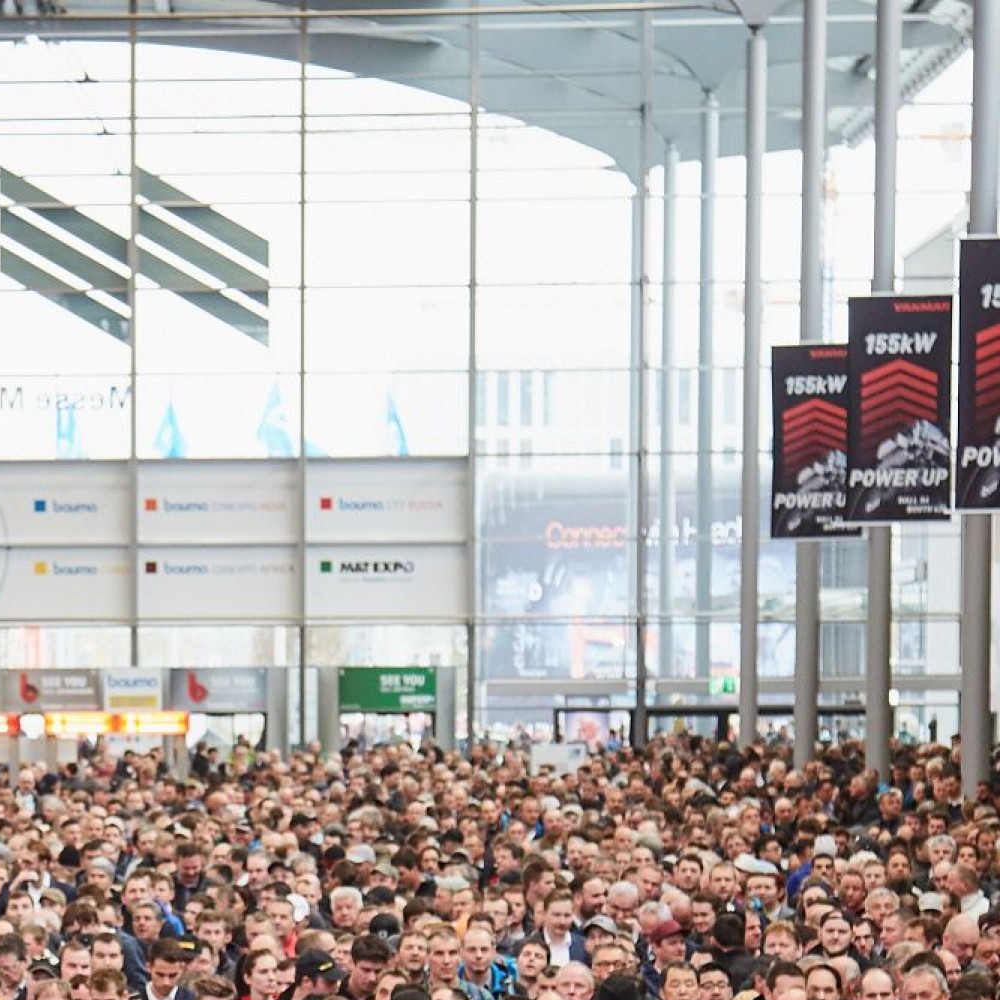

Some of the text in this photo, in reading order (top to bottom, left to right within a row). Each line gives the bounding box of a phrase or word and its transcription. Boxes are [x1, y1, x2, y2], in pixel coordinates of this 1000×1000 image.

[865, 332, 937, 354] 155kW
[785, 375, 848, 395] 155kW
[850, 468, 948, 487] POWER UP
[775, 492, 846, 509] POWER U
[545, 521, 627, 549] Connec
